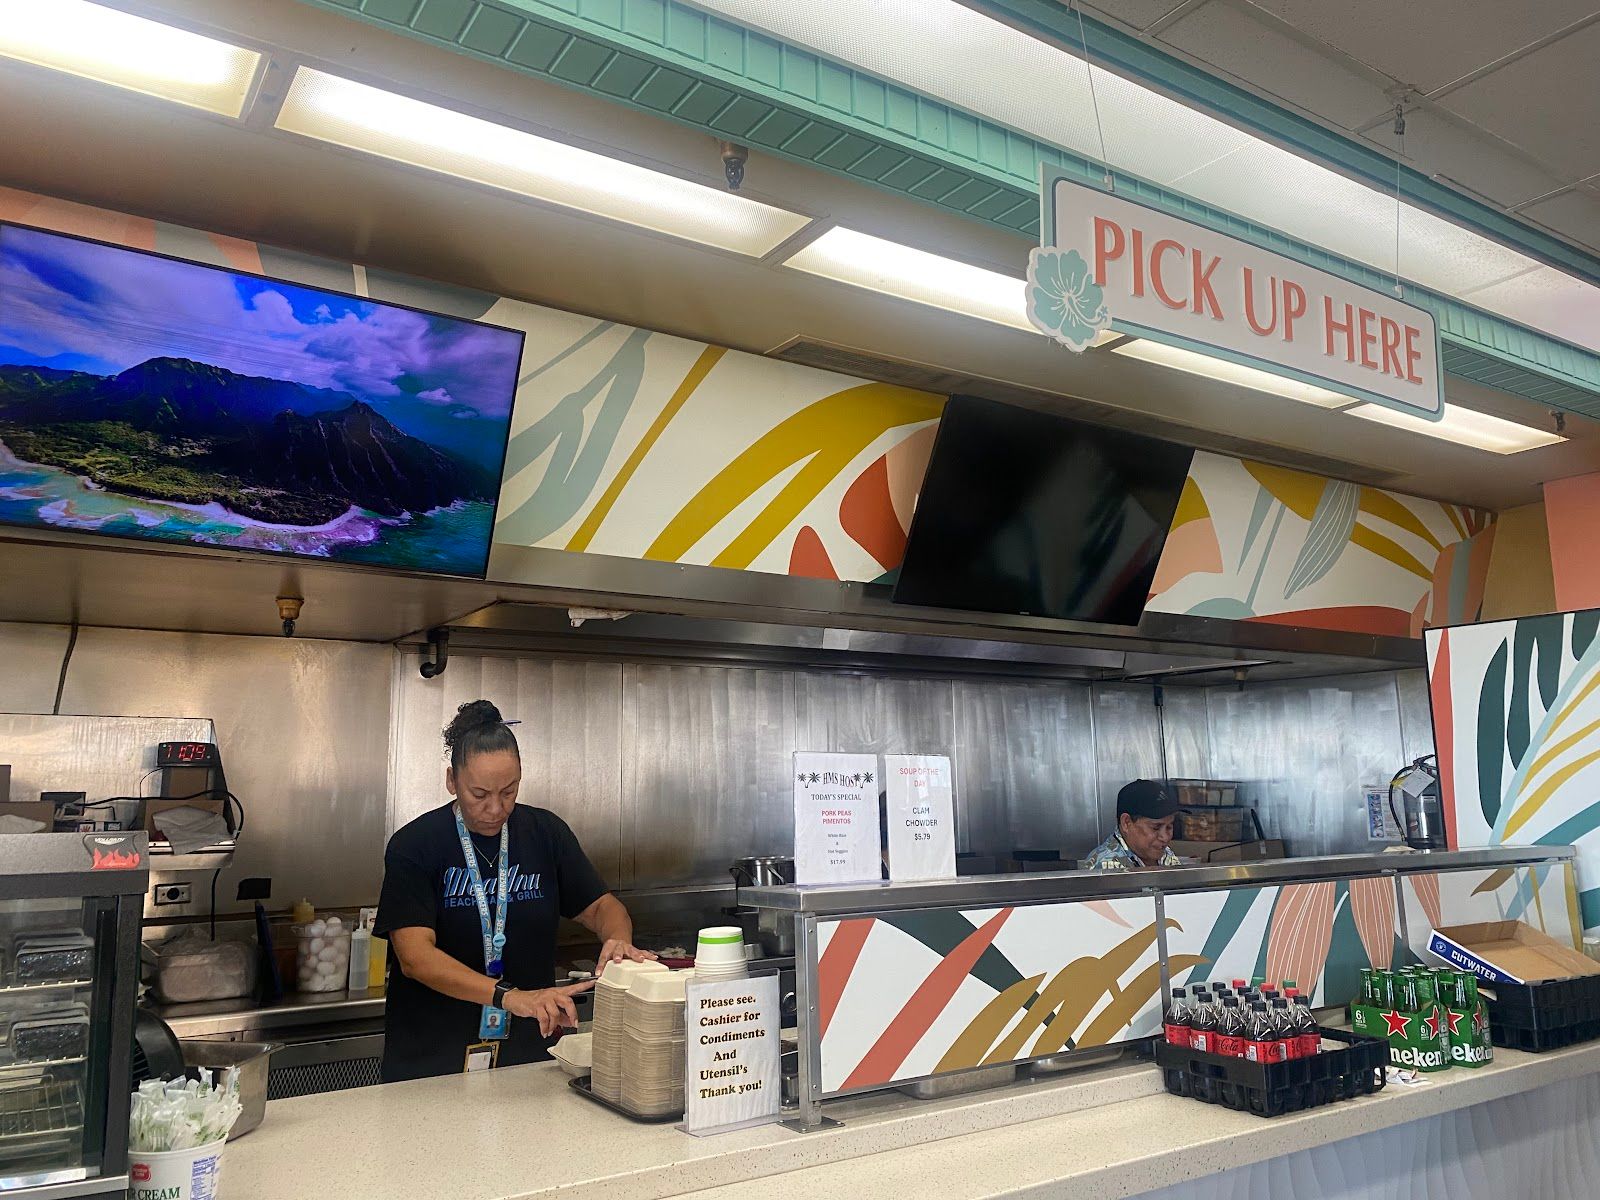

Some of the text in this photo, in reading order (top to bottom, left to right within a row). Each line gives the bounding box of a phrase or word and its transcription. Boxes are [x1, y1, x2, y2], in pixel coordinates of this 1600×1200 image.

[1092, 216, 1423, 386] PICK UP HERE
[823, 772, 838, 784] HMS
[899, 767, 917, 775] SOUP
[914, 780, 926, 788] DAY
[811, 793, 836, 801] TODAY'S
[912, 807, 930, 815] CLAM
[905, 819, 938, 827] CHOWDER
[914, 833, 931, 841] $5.79
[516, 888, 545, 902] GRILL
[1451, 949, 1497, 981] CUTWATER
[700, 994, 756, 1009] Please see.
[700, 1011, 761, 1027] Cashier for
[1355, 1009, 1362, 1020] 6
[700, 1028, 766, 1045] Condiments
[713, 1049, 737, 1061] And
[1390, 1046, 1444, 1067] neken
[700, 1064, 748, 1081] Utensil's
[700, 1079, 762, 1099] Thank you!
[138, 1186, 181, 1200] CREAM
